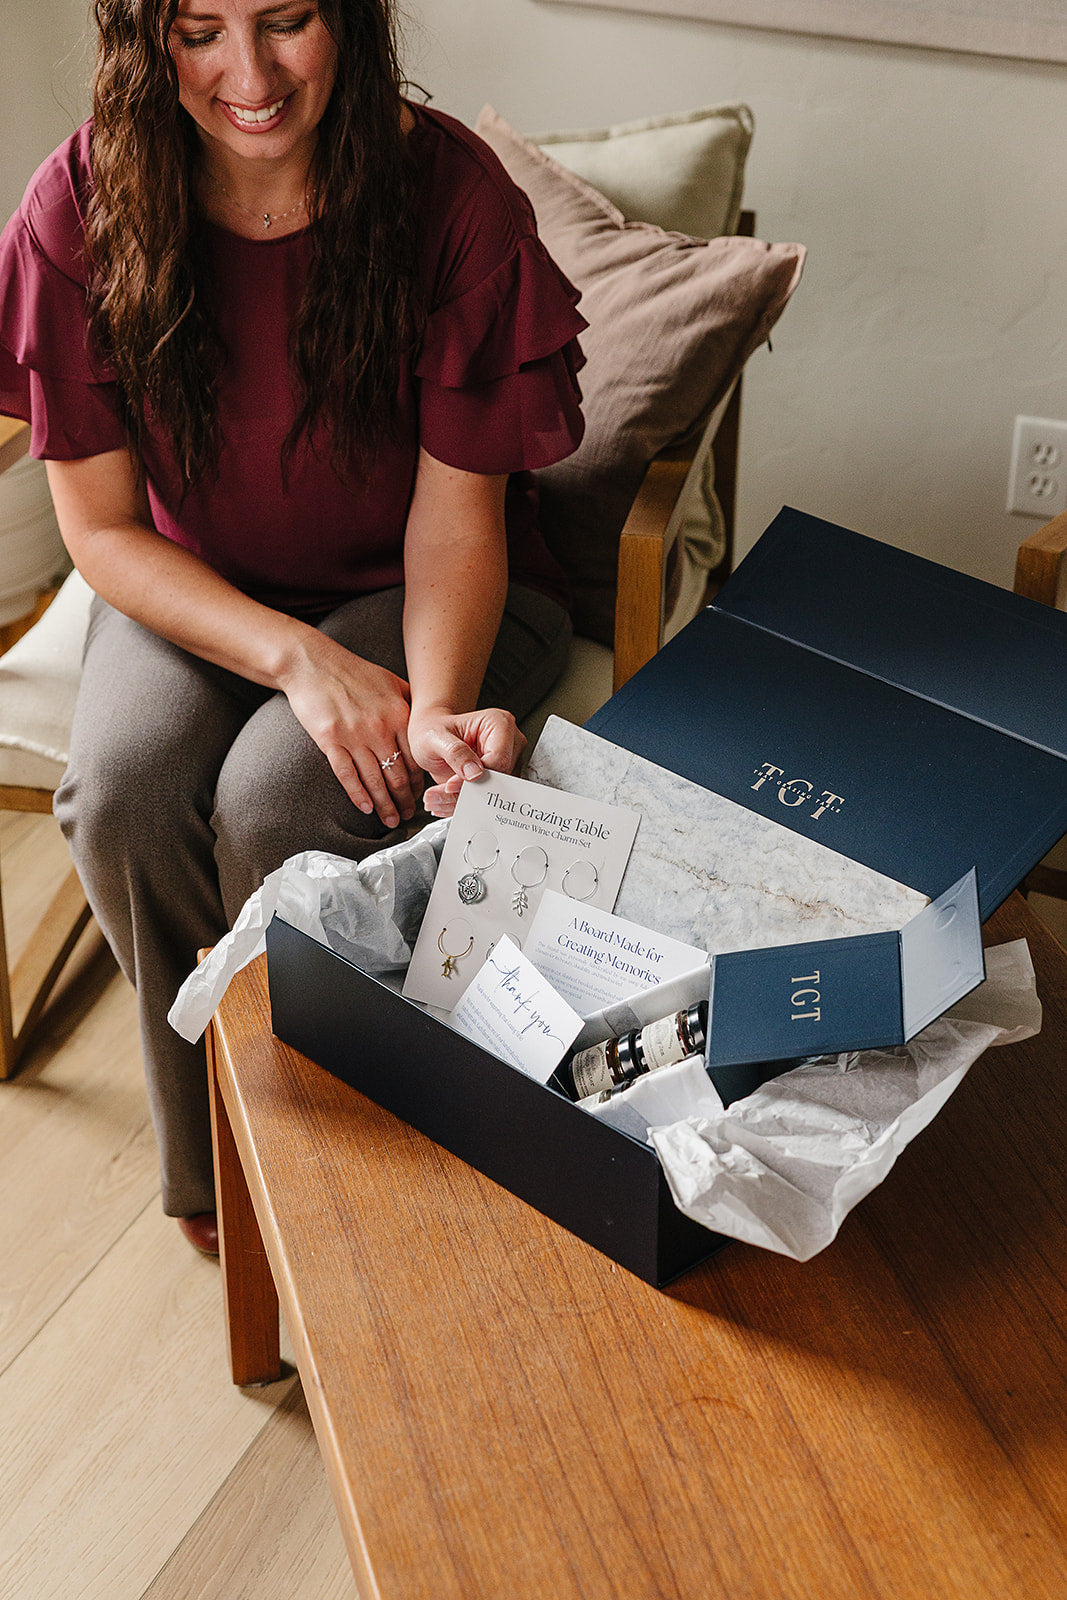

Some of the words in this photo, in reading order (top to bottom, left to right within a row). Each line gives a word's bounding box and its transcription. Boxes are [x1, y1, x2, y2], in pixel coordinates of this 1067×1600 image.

[487, 791, 516, 813] That
[519, 802, 573, 832] Grazing
[575, 818, 611, 840] Table
[750, 762, 845, 820] TGT
[494, 814, 531, 831] Signature
[531, 824, 551, 837] Wine
[551, 830, 578, 845] Charm
[578, 839, 592, 849] Set
[557, 933, 606, 965] Creating
[605, 952, 662, 985] Memories
[568, 917, 577, 930] A
[579, 920, 615, 944] Board
[613, 934, 645, 956] Made
[645, 947, 664, 963] for
[791, 970, 821, 1021] TGT
[521, 1010, 566, 1050] you
